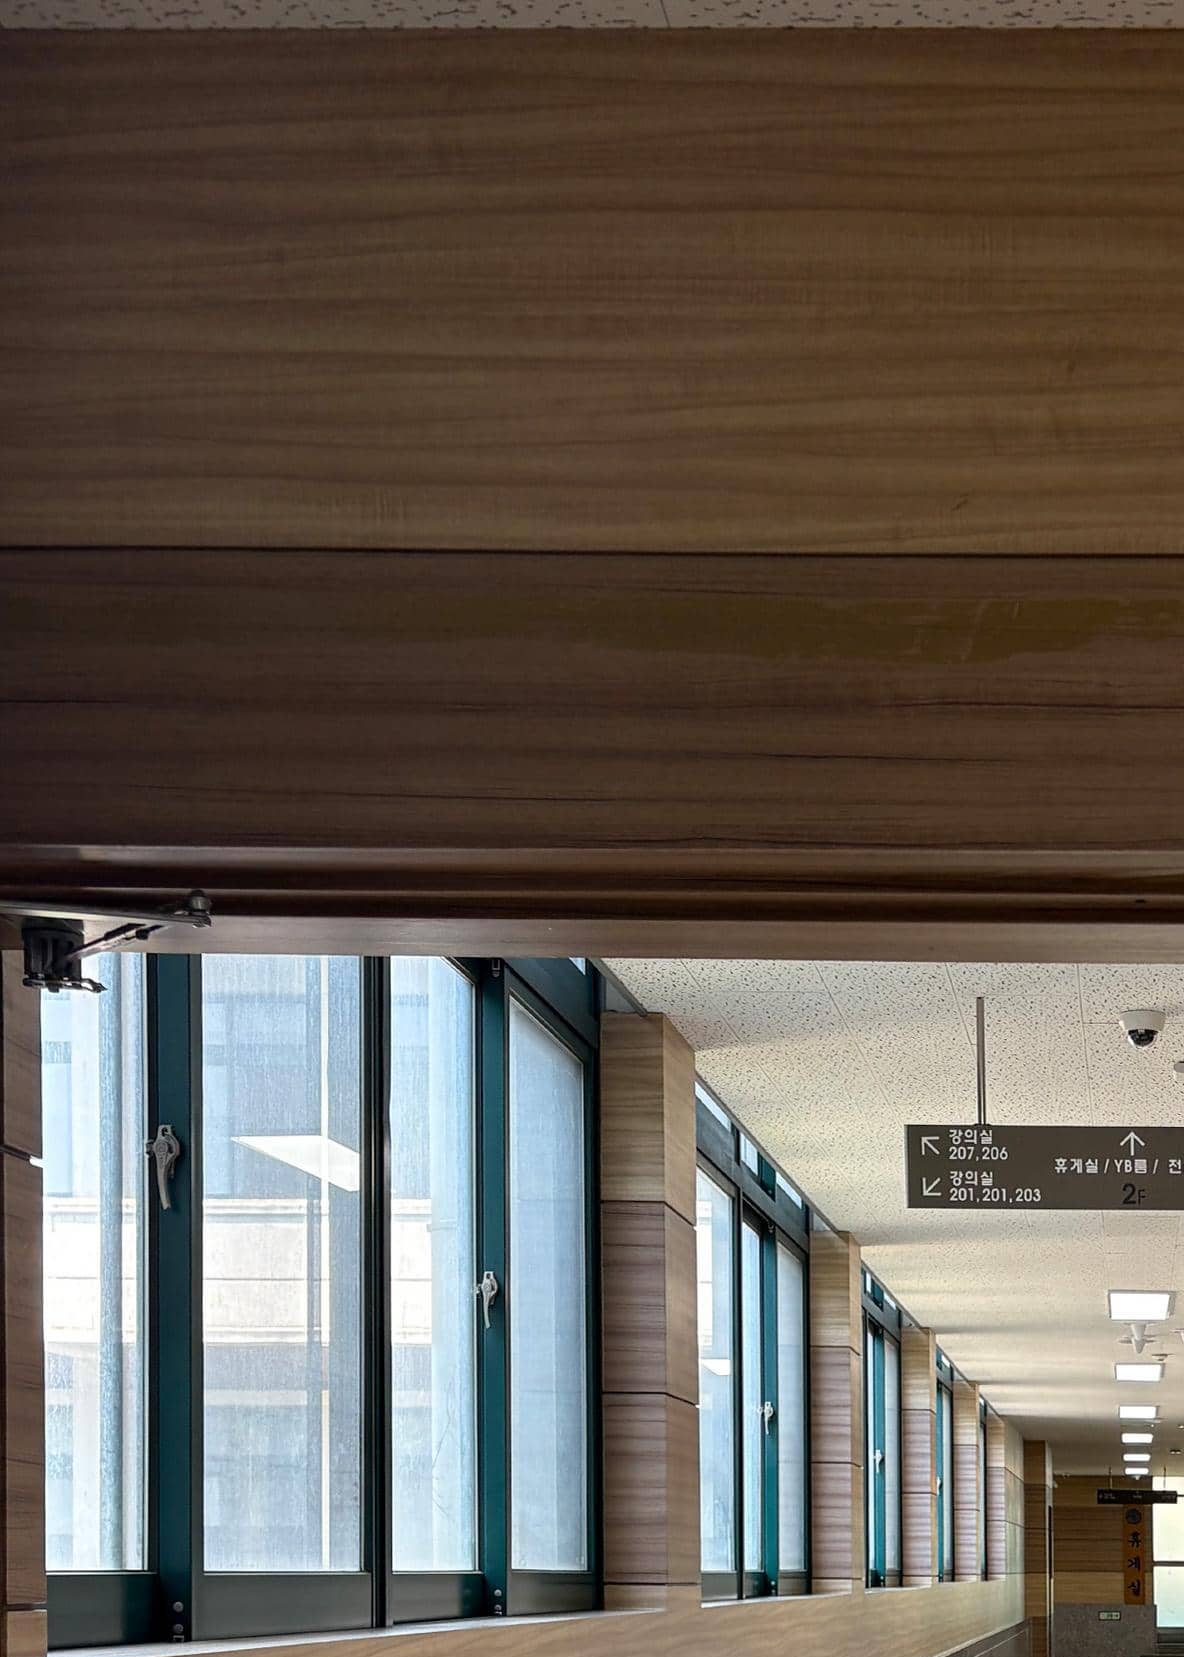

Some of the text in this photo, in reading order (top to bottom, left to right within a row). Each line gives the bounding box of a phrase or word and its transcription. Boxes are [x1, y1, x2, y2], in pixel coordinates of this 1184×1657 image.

[948, 1129, 993, 1145] 강의실
[948, 1147, 1008, 1161] 207,206
[1054, 1157, 1099, 1174] 휴게실
[949, 1170, 993, 1186] 강의실
[949, 1188, 1042, 1203] 201,201,203
[1122, 1182, 1147, 1205] 2F
[1127, 1531, 1142, 1597] 휴게실
